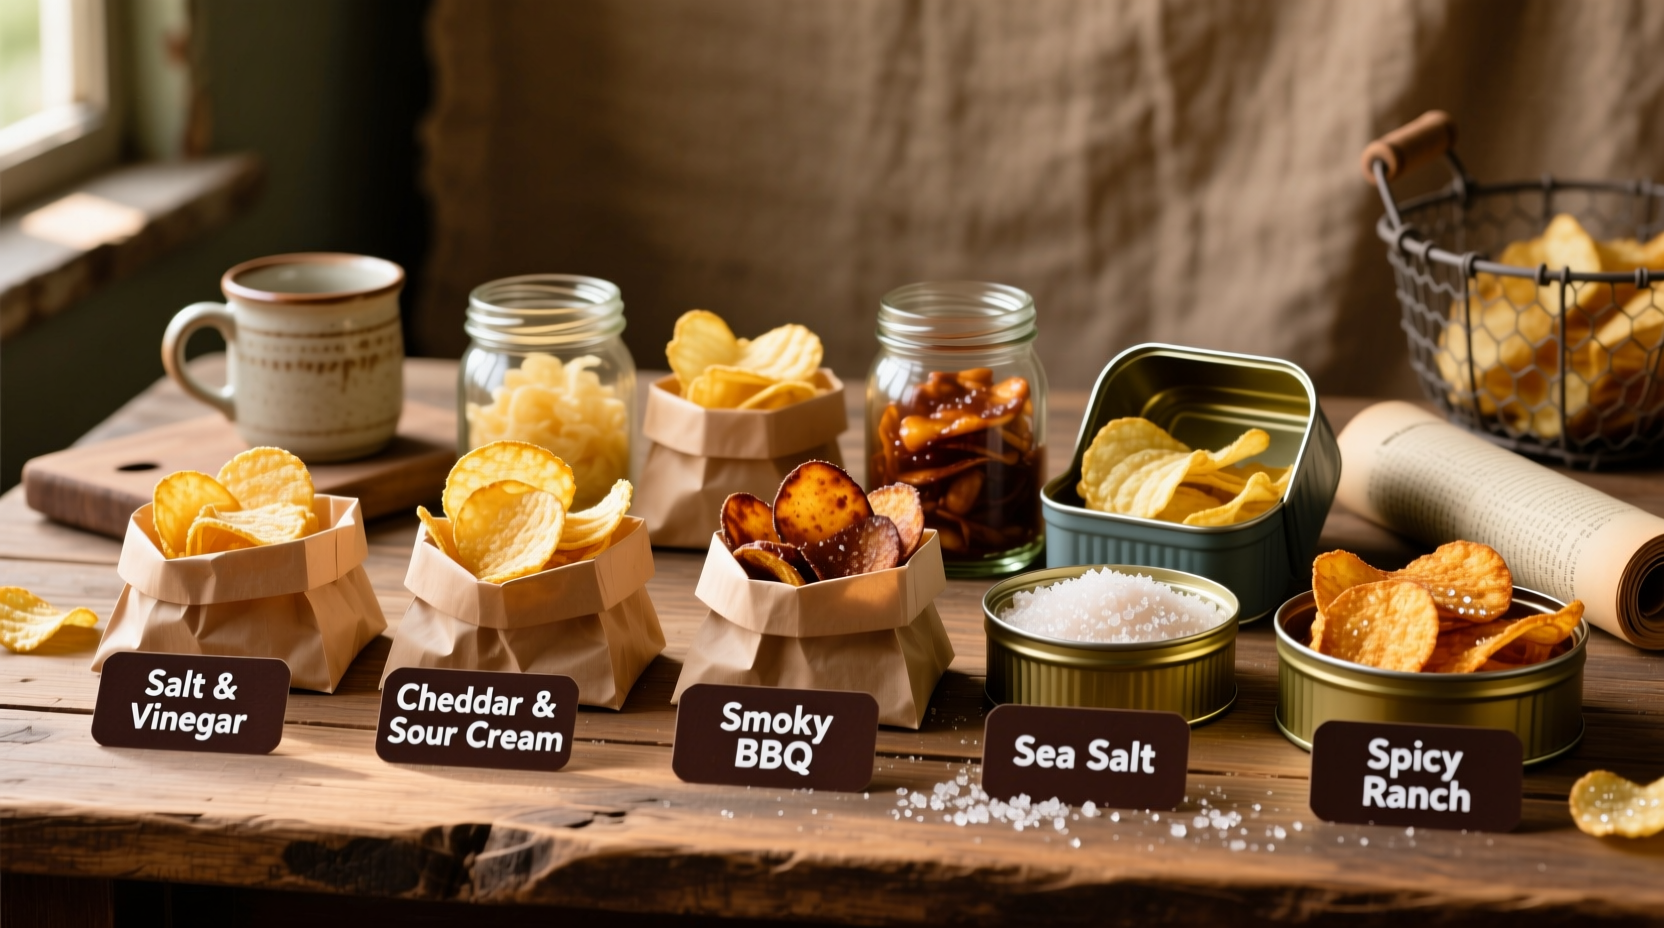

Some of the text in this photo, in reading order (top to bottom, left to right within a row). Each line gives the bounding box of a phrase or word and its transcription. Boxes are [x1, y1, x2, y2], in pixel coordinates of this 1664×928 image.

[144, 668, 238, 701] Salt &
[396, 682, 557, 719] Cheddar &
[131, 702, 248, 741] Vinegar
[387, 716, 564, 753] Sour Cream
[719, 701, 834, 745] Smoky
[734, 737, 813, 776] BBQ
[1012, 734, 1156, 774] Sea Salt
[1367, 737, 1464, 782] Spicy
[1362, 775, 1471, 813] Ranch
